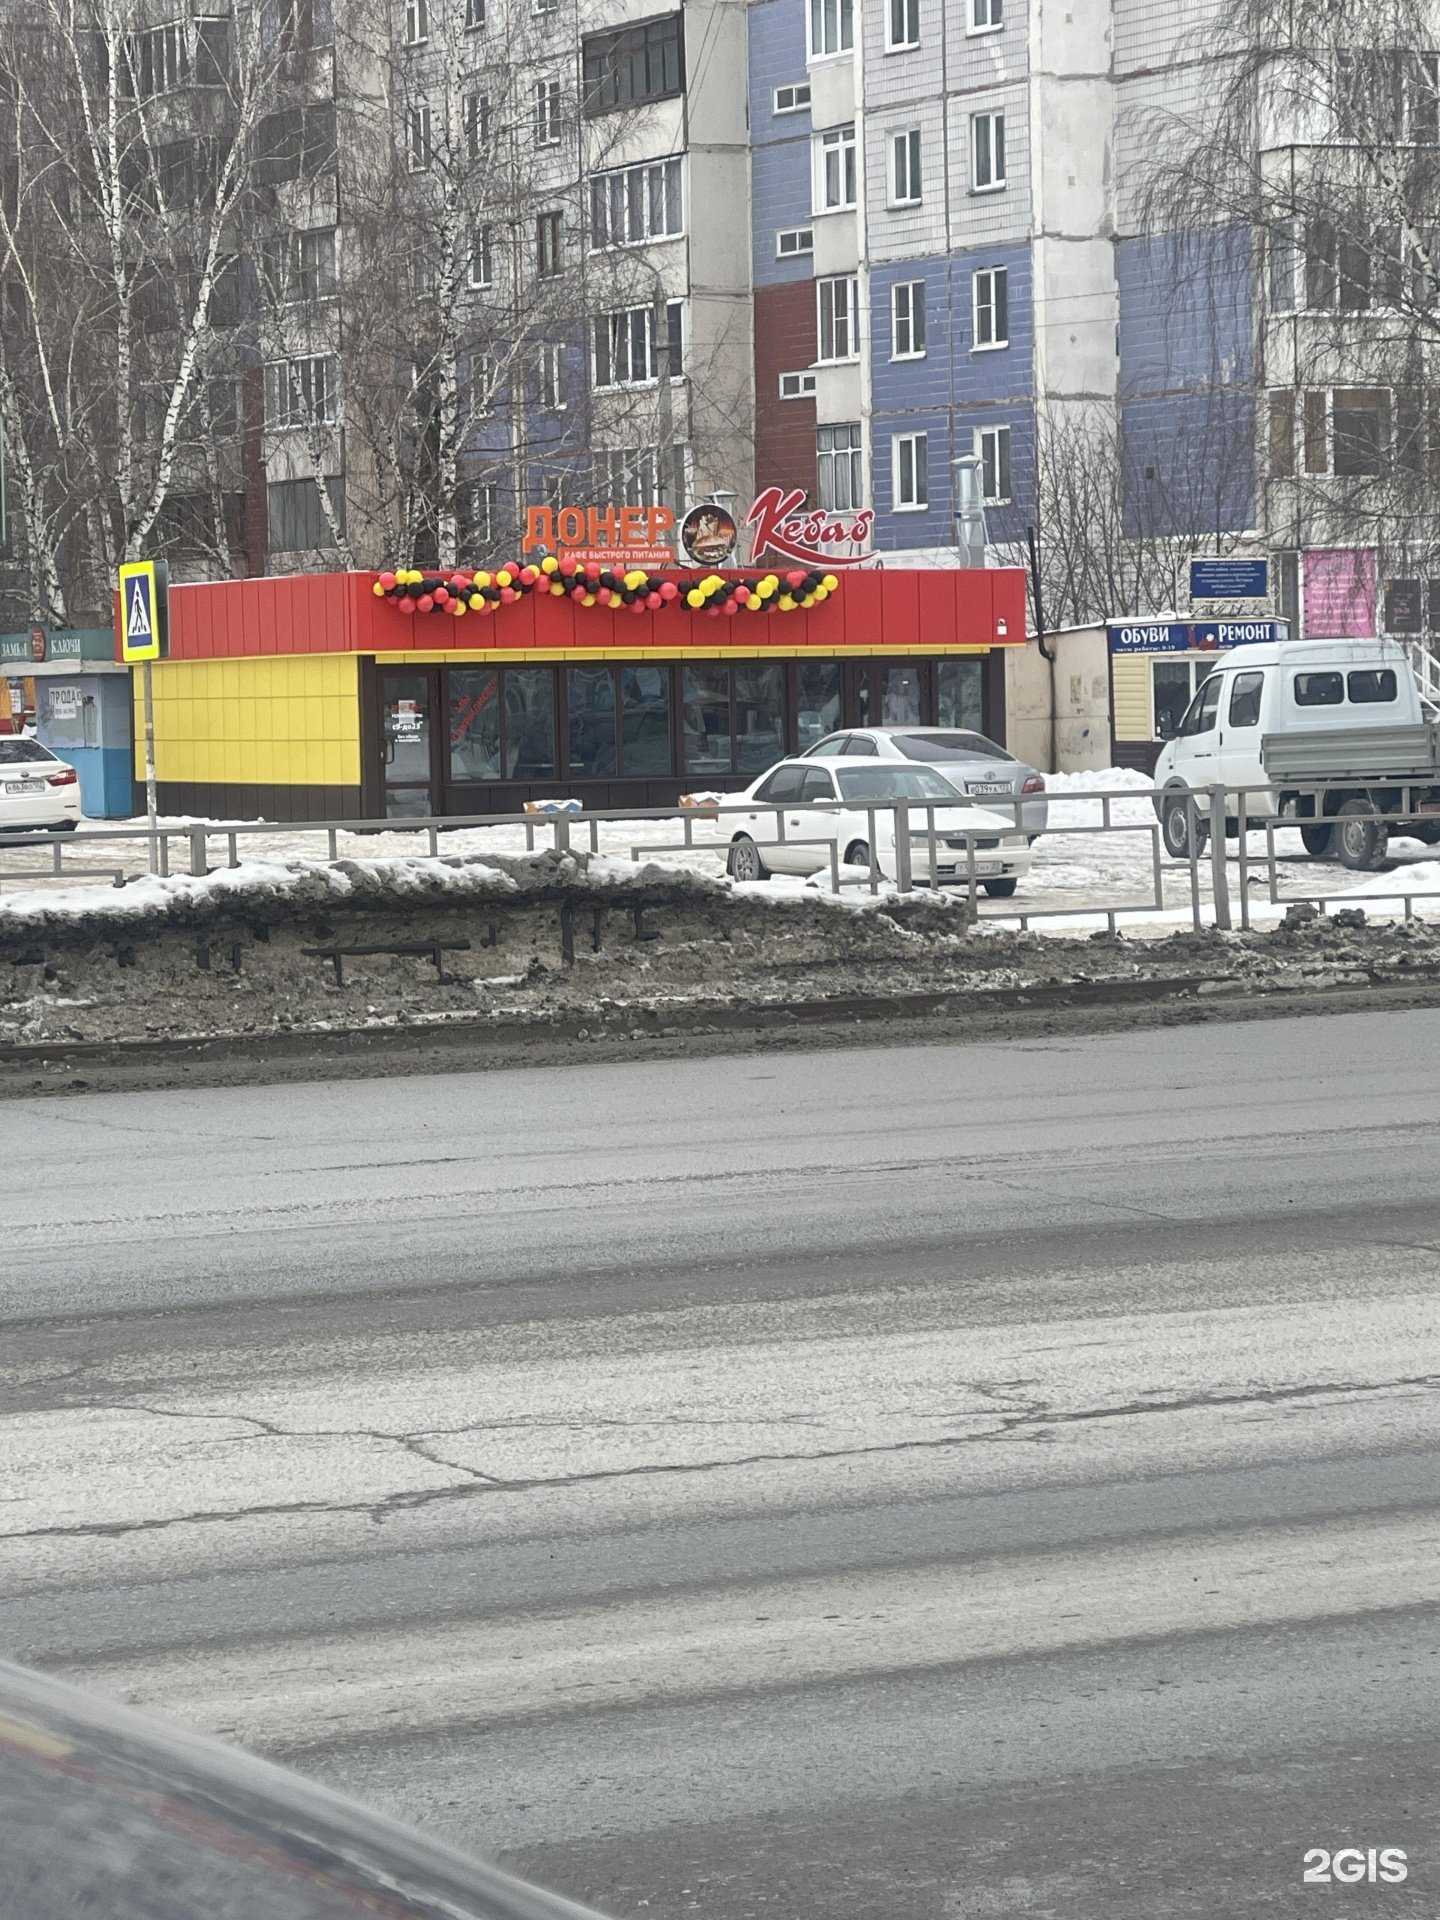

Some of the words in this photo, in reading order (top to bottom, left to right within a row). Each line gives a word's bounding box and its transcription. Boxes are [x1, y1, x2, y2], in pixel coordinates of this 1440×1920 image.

[522, 506, 674, 554] ДОНЕР
[746, 487, 880, 566] Кебаб
[564, 551, 587, 560] КАФЕ
[589, 551, 630, 560] БЫСТРОГО
[632, 550, 671, 559] ПИТАНИЯ
[1121, 626, 1169, 644] ОБУВИ
[1218, 624, 1271, 642] РЕМОНТ
[51, 638, 81, 654] КЛЮЧИ
